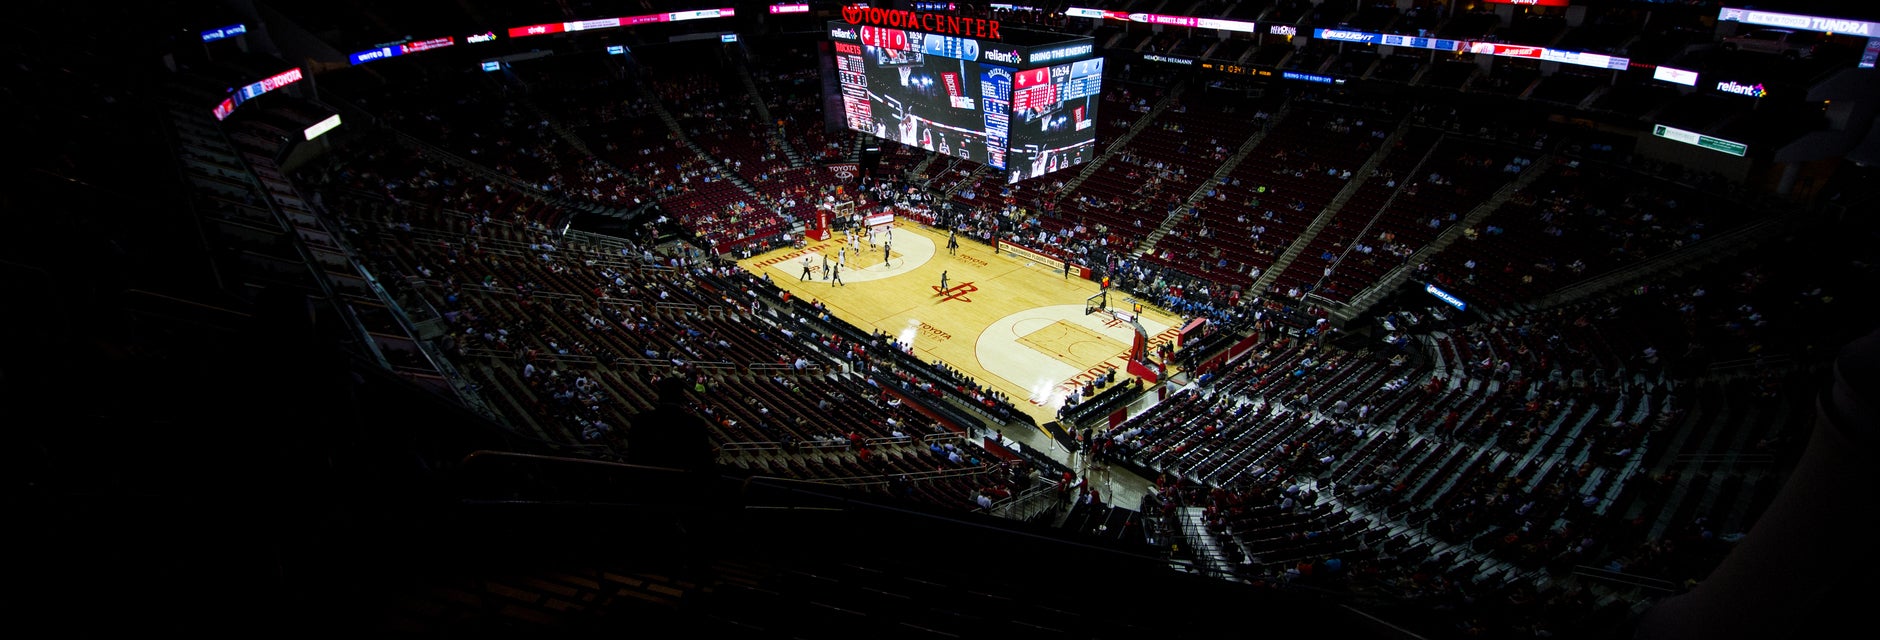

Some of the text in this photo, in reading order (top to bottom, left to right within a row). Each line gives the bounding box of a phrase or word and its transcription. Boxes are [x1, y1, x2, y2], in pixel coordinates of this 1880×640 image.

[861, 7, 1001, 39] TOYOTA CENTER
[1812, 18, 1868, 34] TUNDRA
[831, 28, 851, 39] reliant
[896, 34, 902, 45] 0
[1328, 30, 1347, 39] BUD
[1347, 31, 1374, 41] LIGHT
[935, 40, 941, 50] 2
[985, 49, 1013, 63] reliant
[1030, 45, 1092, 62] BRING THE ENERGY!
[1143, 54, 1167, 62] MEMORIAL
[1052, 66, 1070, 77] 10:34
[1082, 63, 1089, 73] 2
[272, 68, 303, 88] TOYOTA
[1036, 71, 1043, 83] 0
[1717, 81, 1754, 96] reliant
[753, 243, 832, 269] HOUSTON
[960, 254, 988, 266] TOYOTA
[919, 322, 951, 340] TOYOTA
